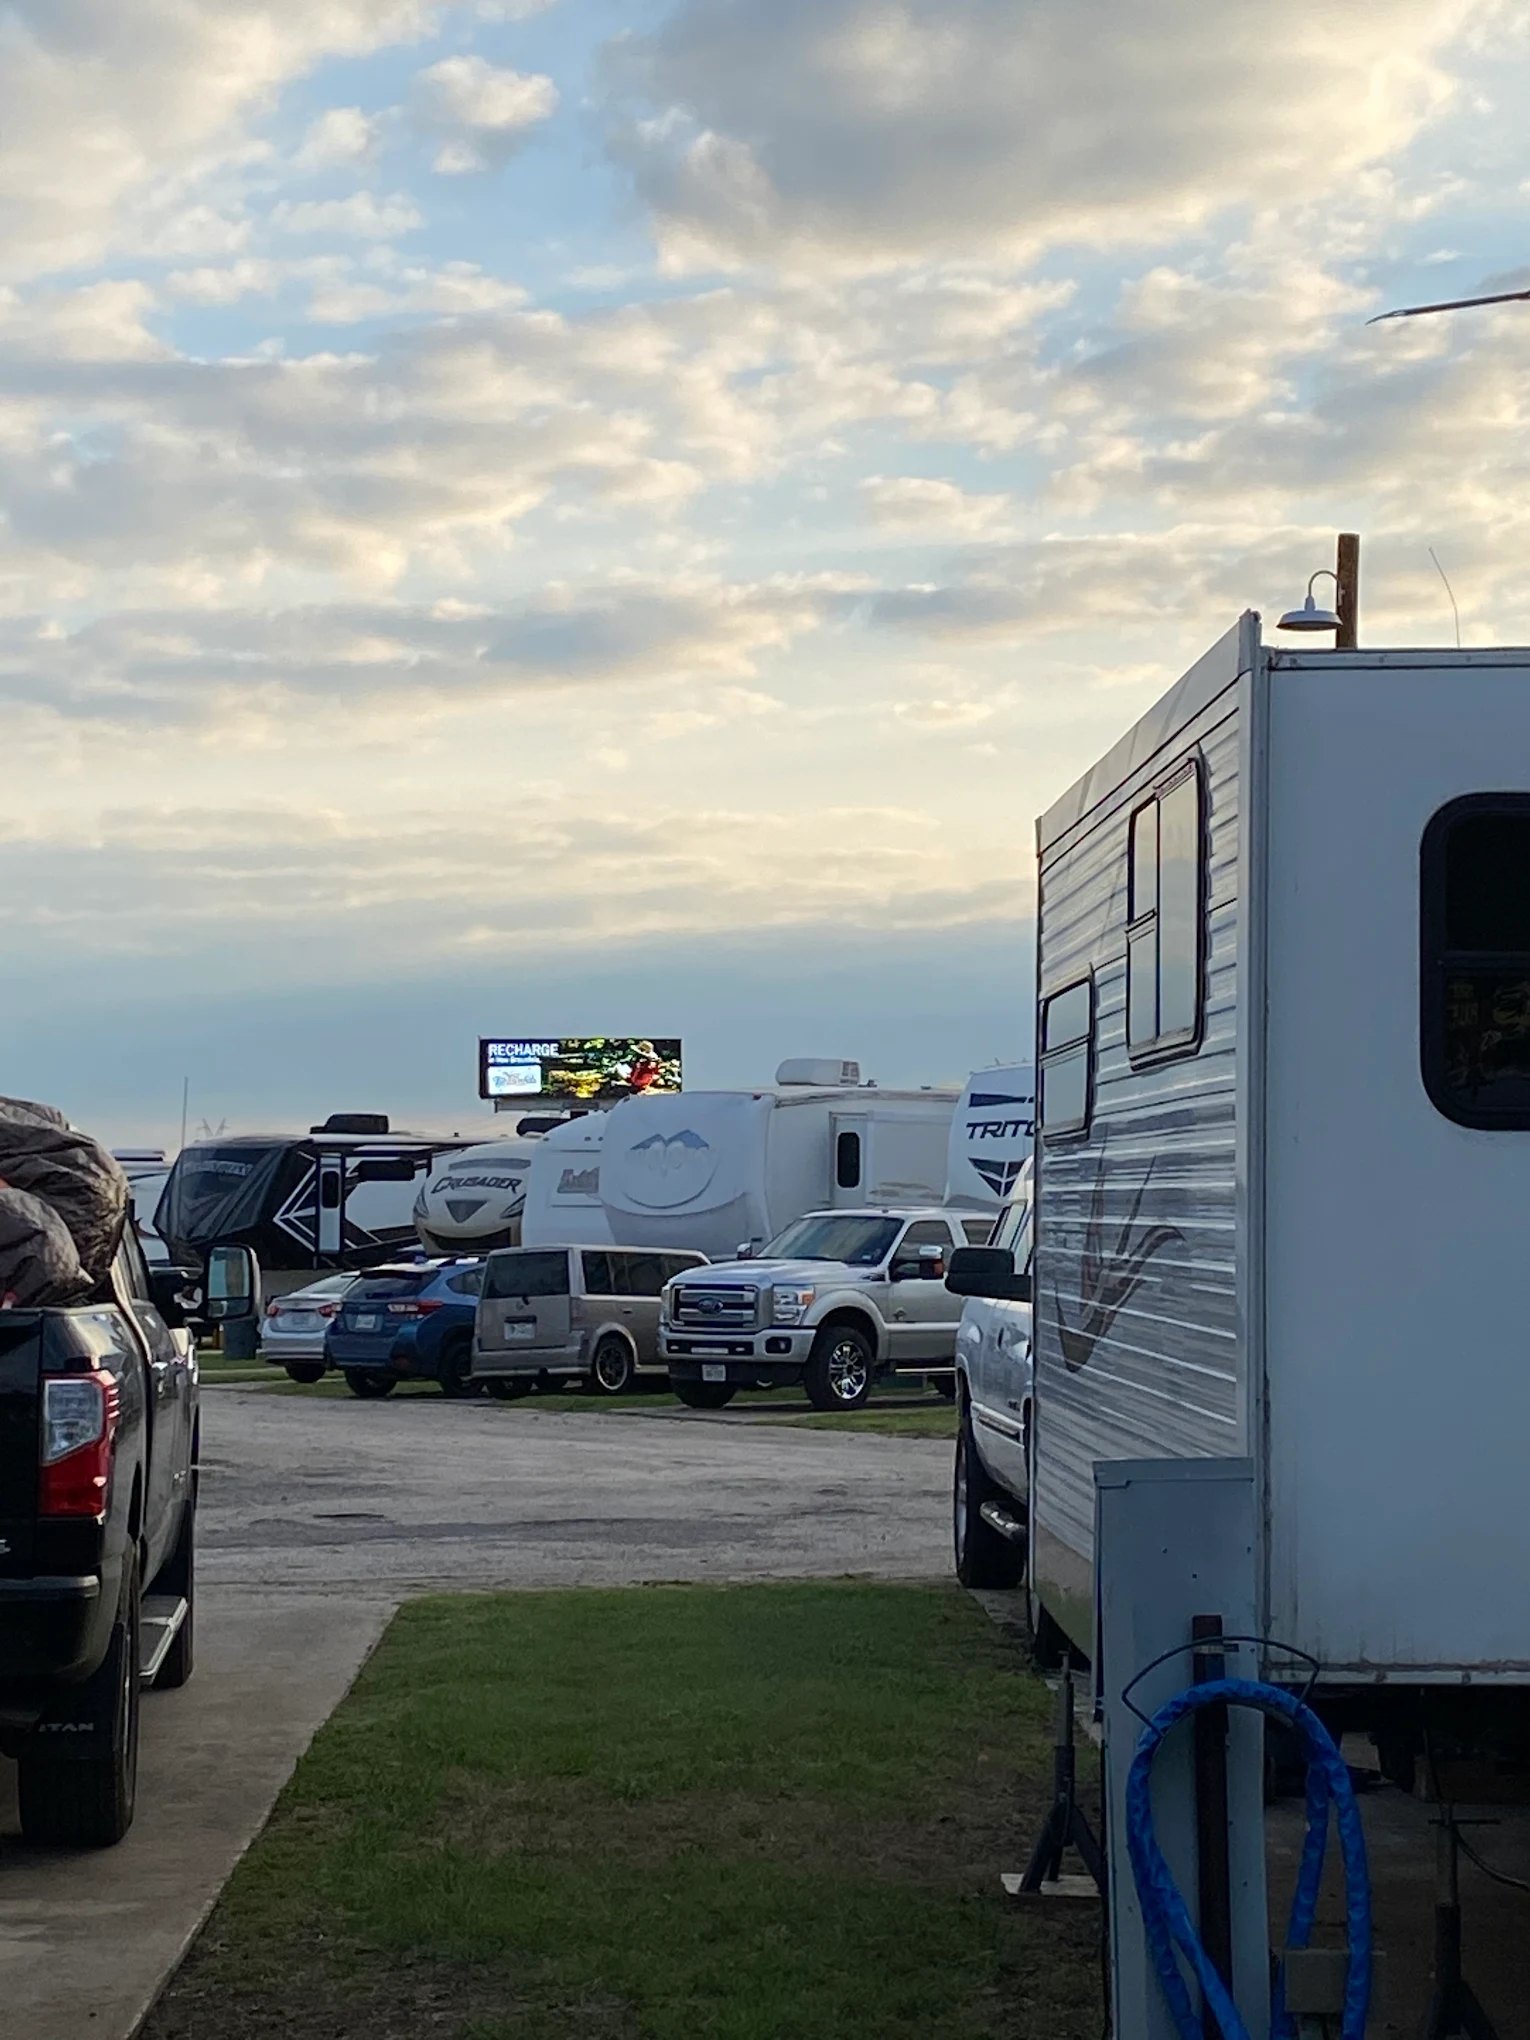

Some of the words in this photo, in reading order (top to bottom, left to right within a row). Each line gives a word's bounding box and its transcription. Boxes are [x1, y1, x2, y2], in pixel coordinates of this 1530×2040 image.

[488, 1043, 559, 1056] RECHARGE
[966, 1120, 1035, 1139] TRITO
[431, 1176, 522, 1194] CRUSADER
